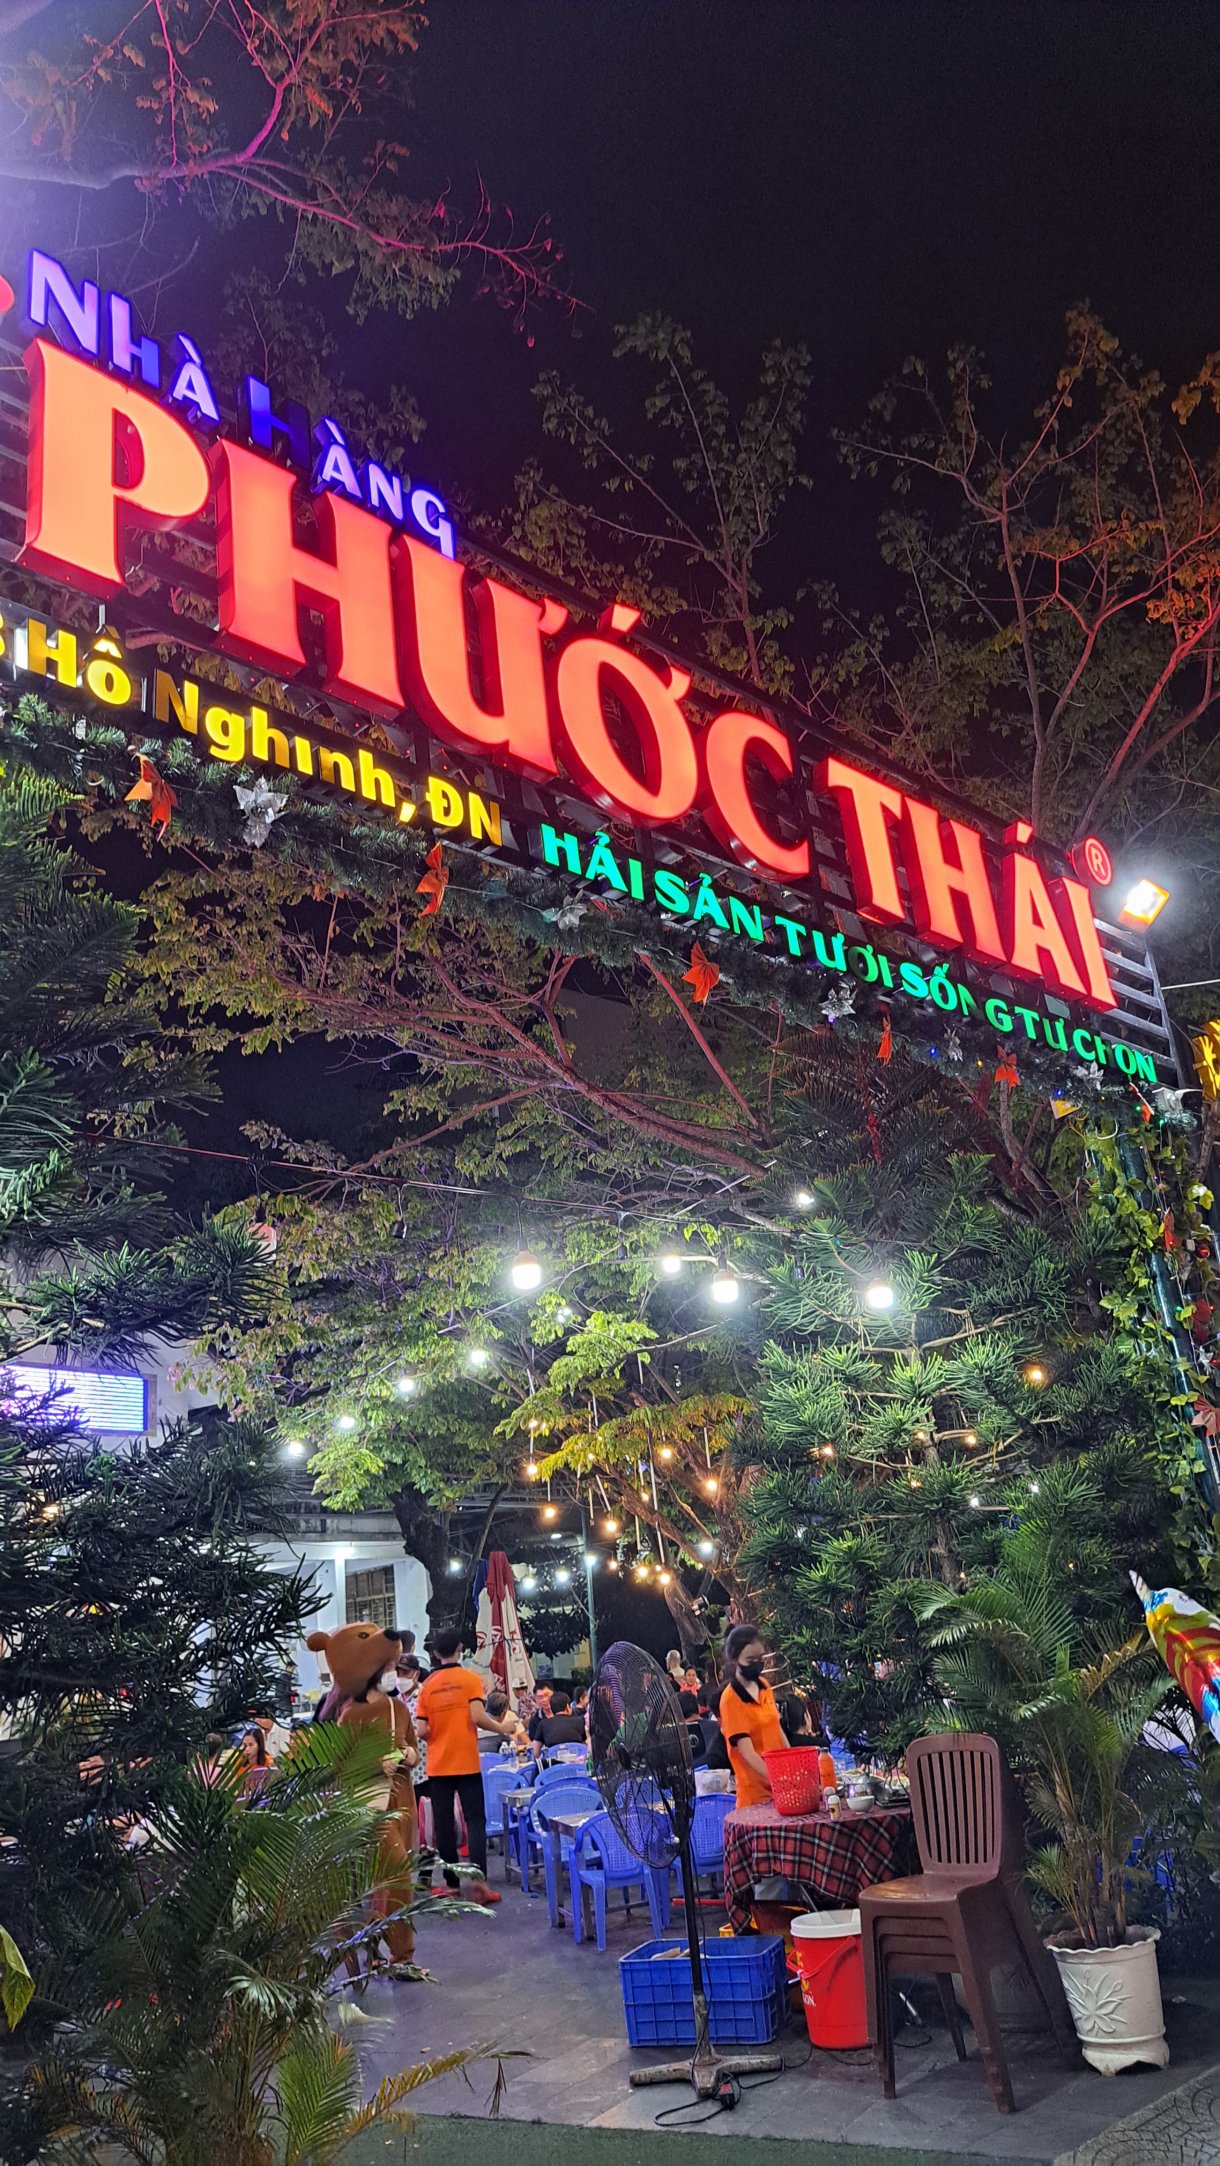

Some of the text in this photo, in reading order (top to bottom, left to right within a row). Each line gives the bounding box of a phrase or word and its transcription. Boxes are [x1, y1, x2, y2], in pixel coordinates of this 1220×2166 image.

[29, 249, 456, 560] NHÀ HÀNG
[26, 337, 810, 877] PHƯỚC
[827, 758, 1118, 1009] THÁI
[541, 823, 645, 901] HẢI
[654, 869, 765, 943] SẢN
[775, 914, 894, 989] TƯƠI
[899, 961, 1013, 1033] SỐNG
